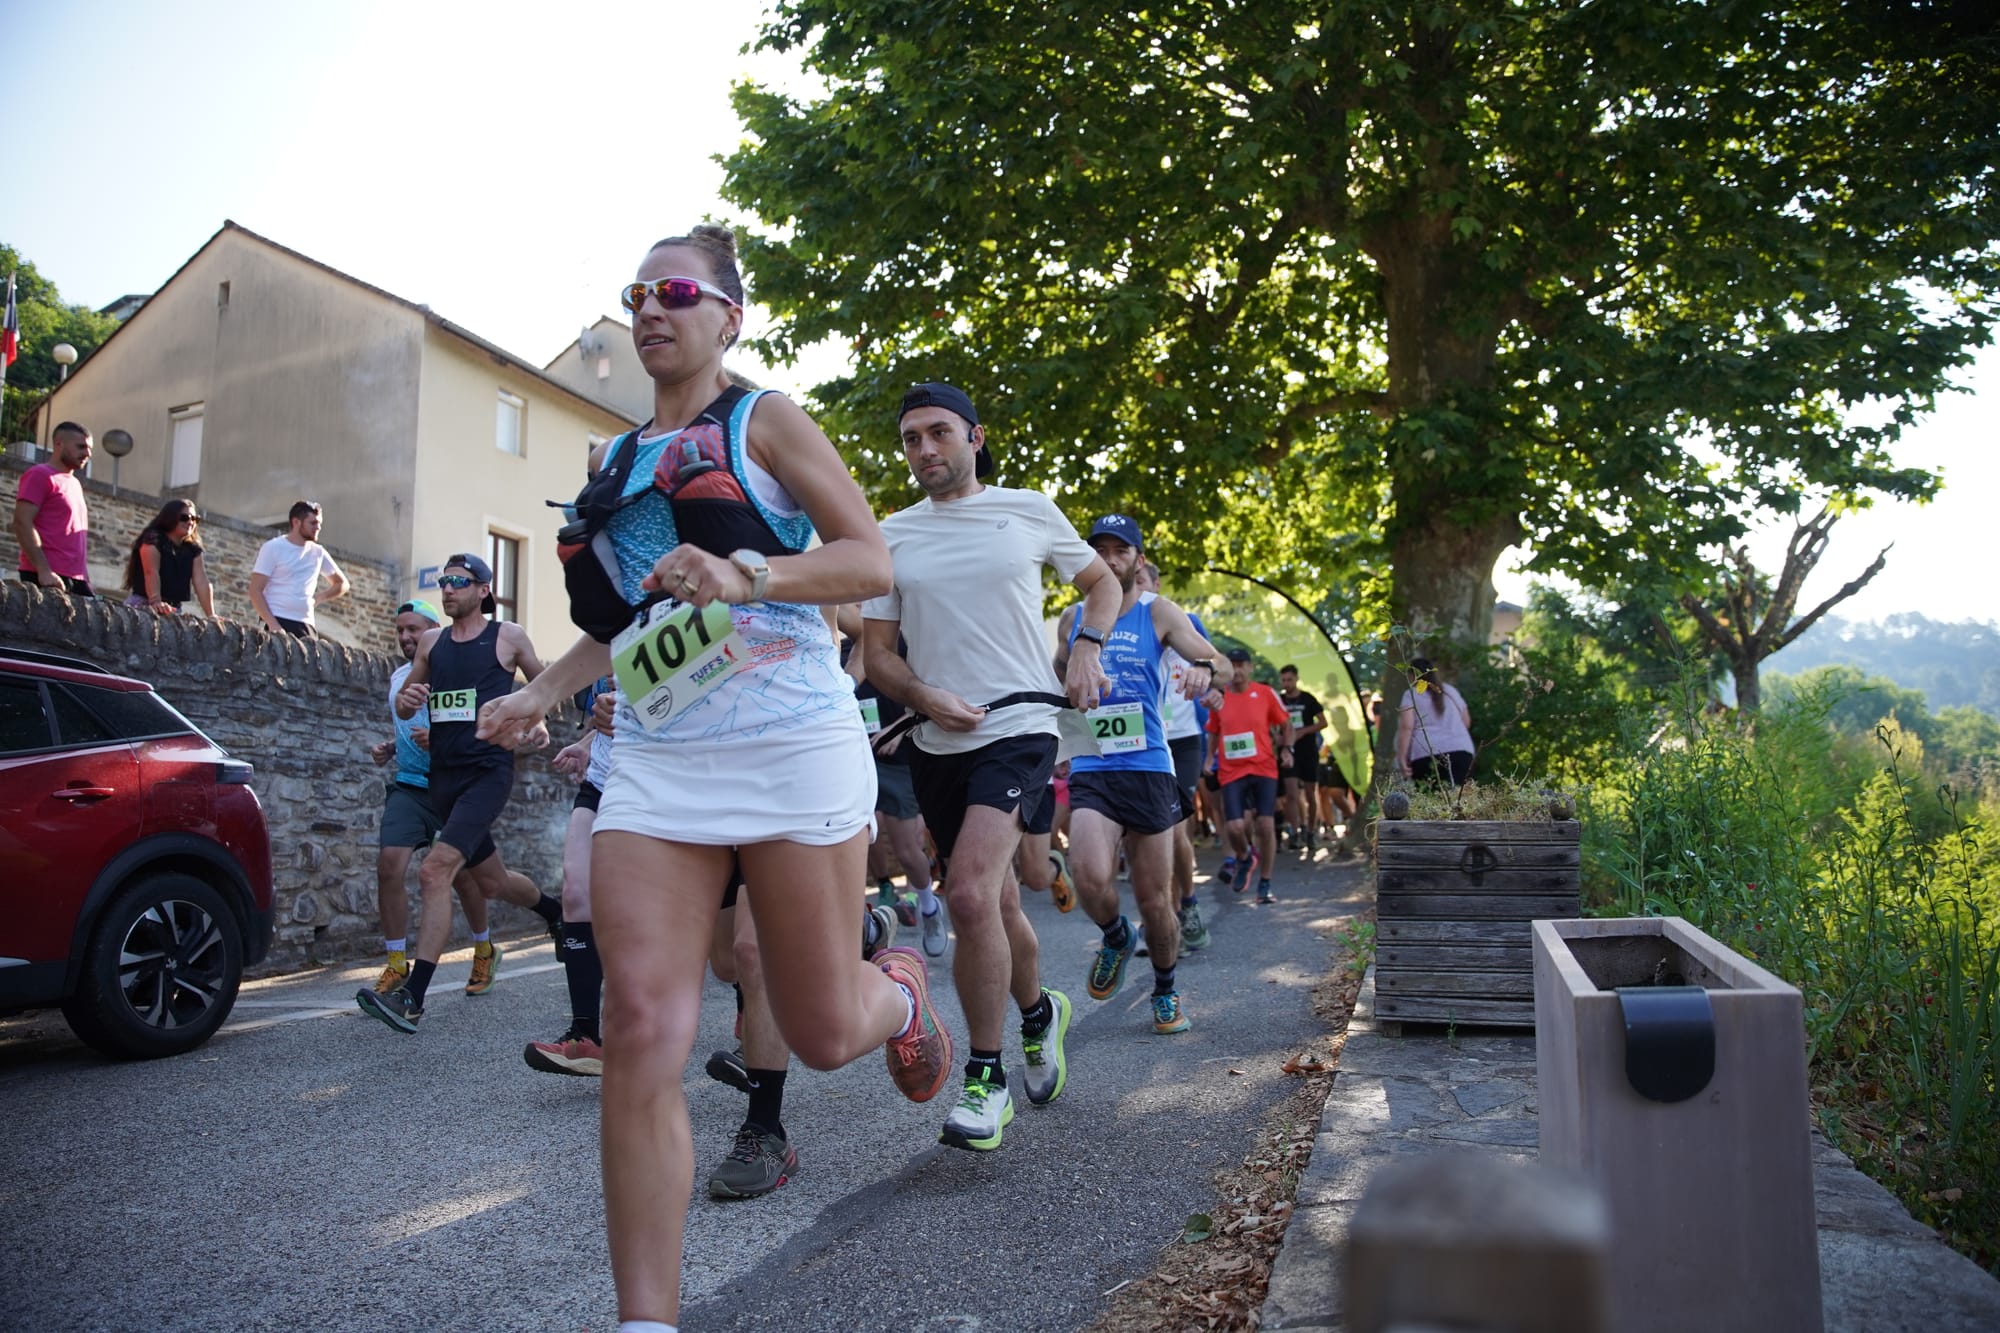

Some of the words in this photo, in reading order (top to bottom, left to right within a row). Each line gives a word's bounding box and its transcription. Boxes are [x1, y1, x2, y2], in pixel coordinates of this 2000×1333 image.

[632, 607, 711, 685] 101
[689, 655, 724, 683] TUFF'S
[430, 692, 467, 709] 105
[1095, 717, 1127, 738] 20
[1231, 740, 1247, 751] 88
